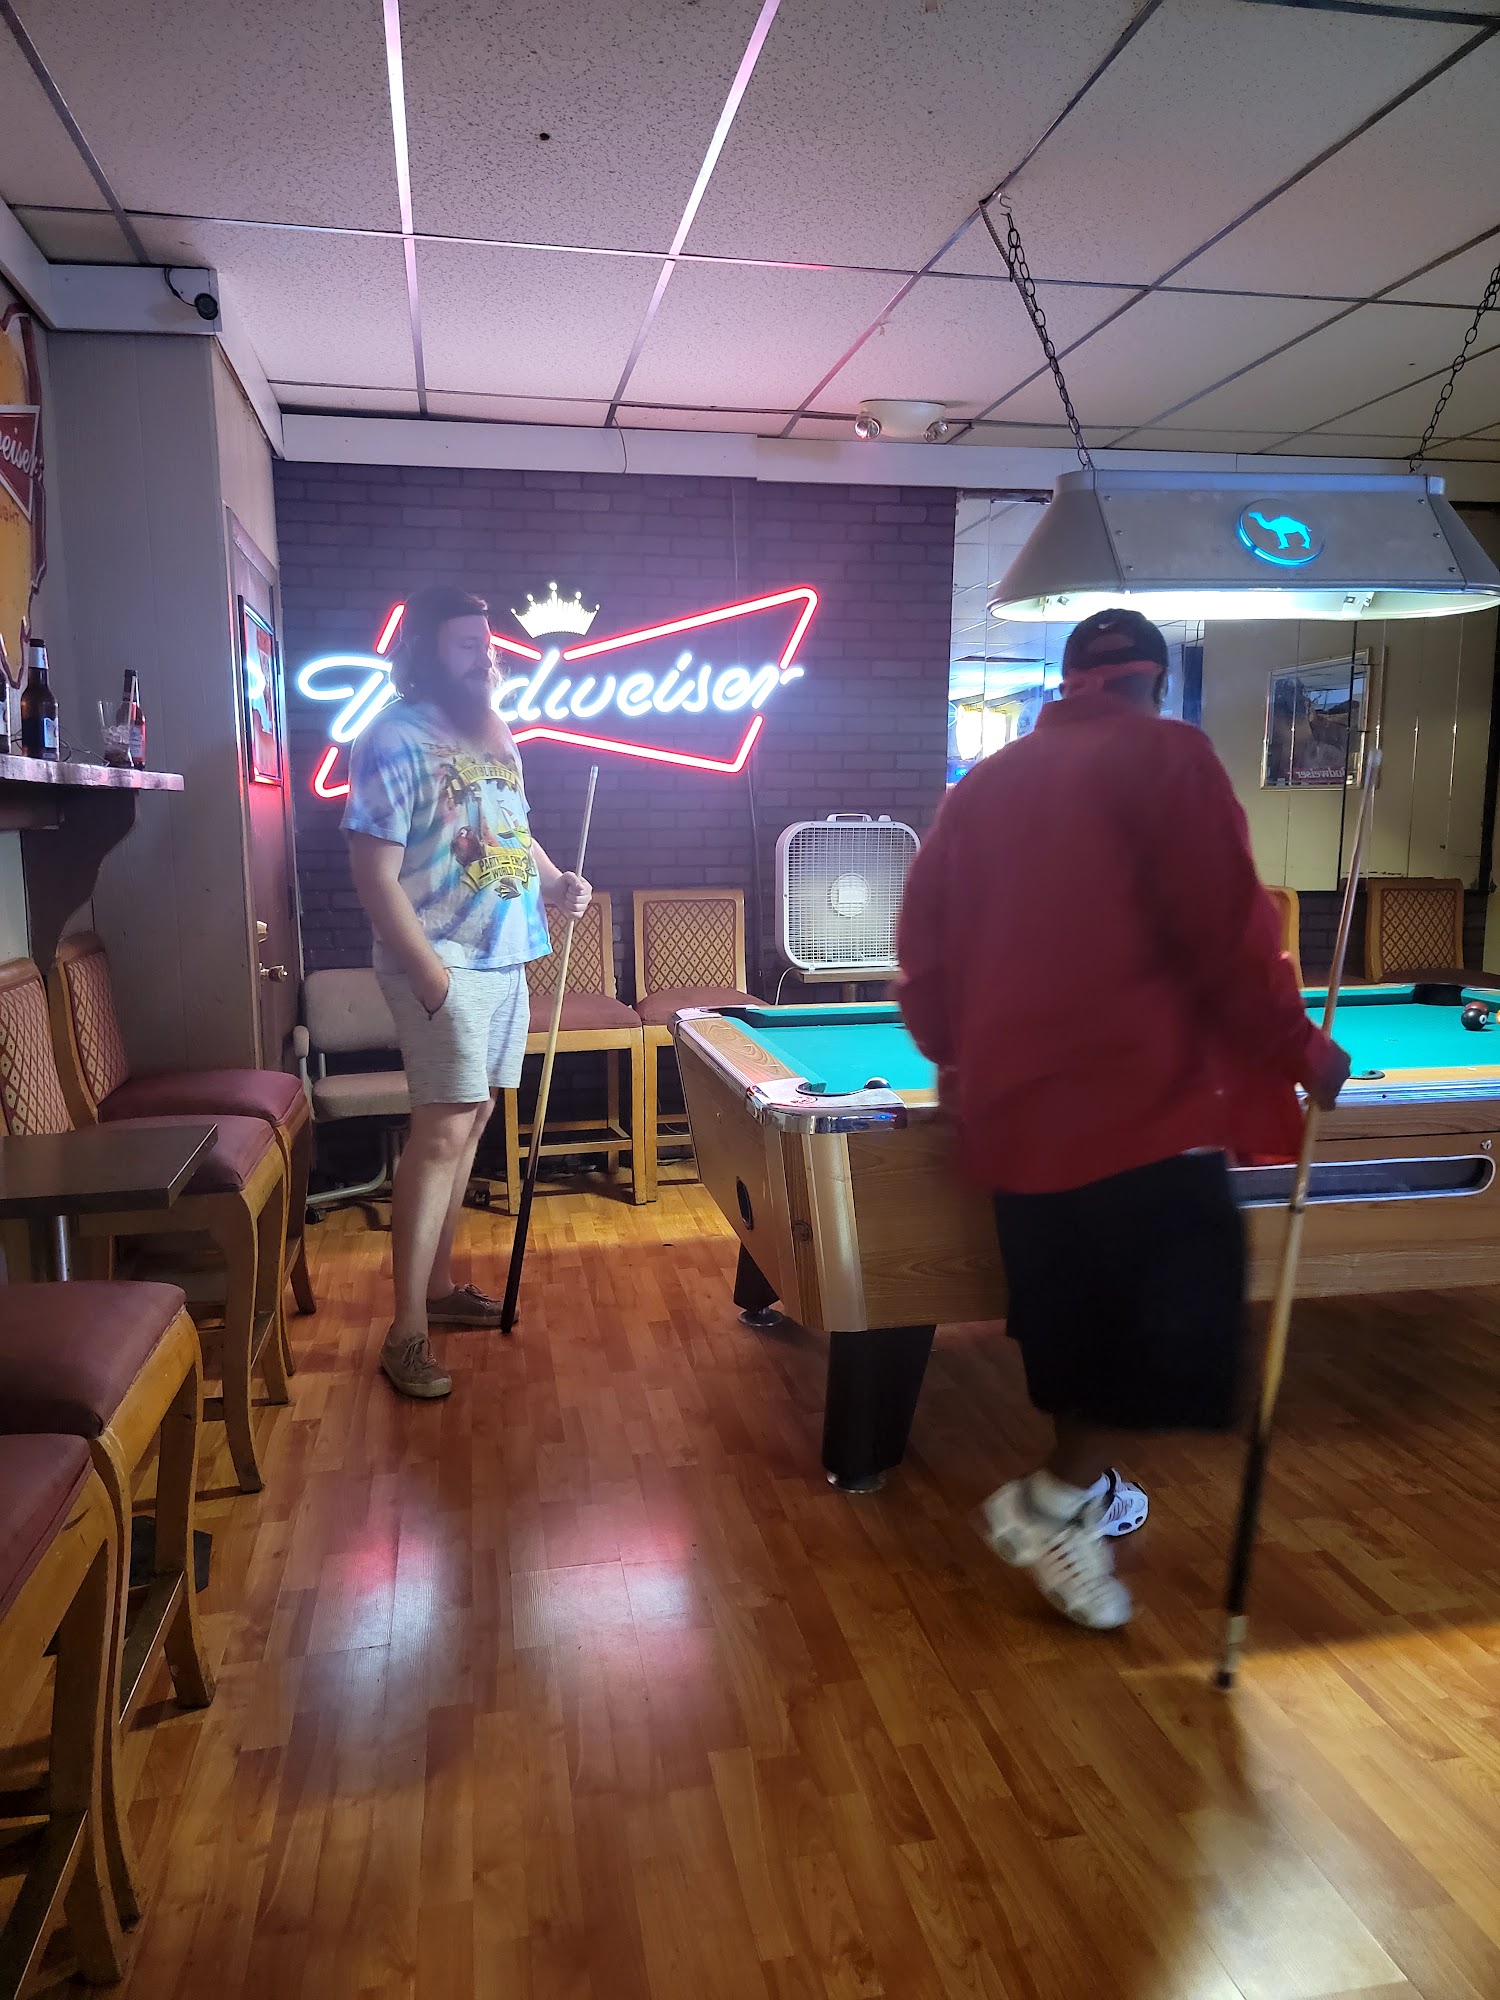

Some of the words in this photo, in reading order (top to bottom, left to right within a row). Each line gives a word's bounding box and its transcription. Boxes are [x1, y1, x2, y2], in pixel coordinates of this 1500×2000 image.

[0, 427, 38, 477] eiser
[297, 649, 804, 742] Bdweiser
[479, 856, 500, 873] PARTY
[511, 855, 523, 867] END
[492, 865, 514, 879] WORLD
